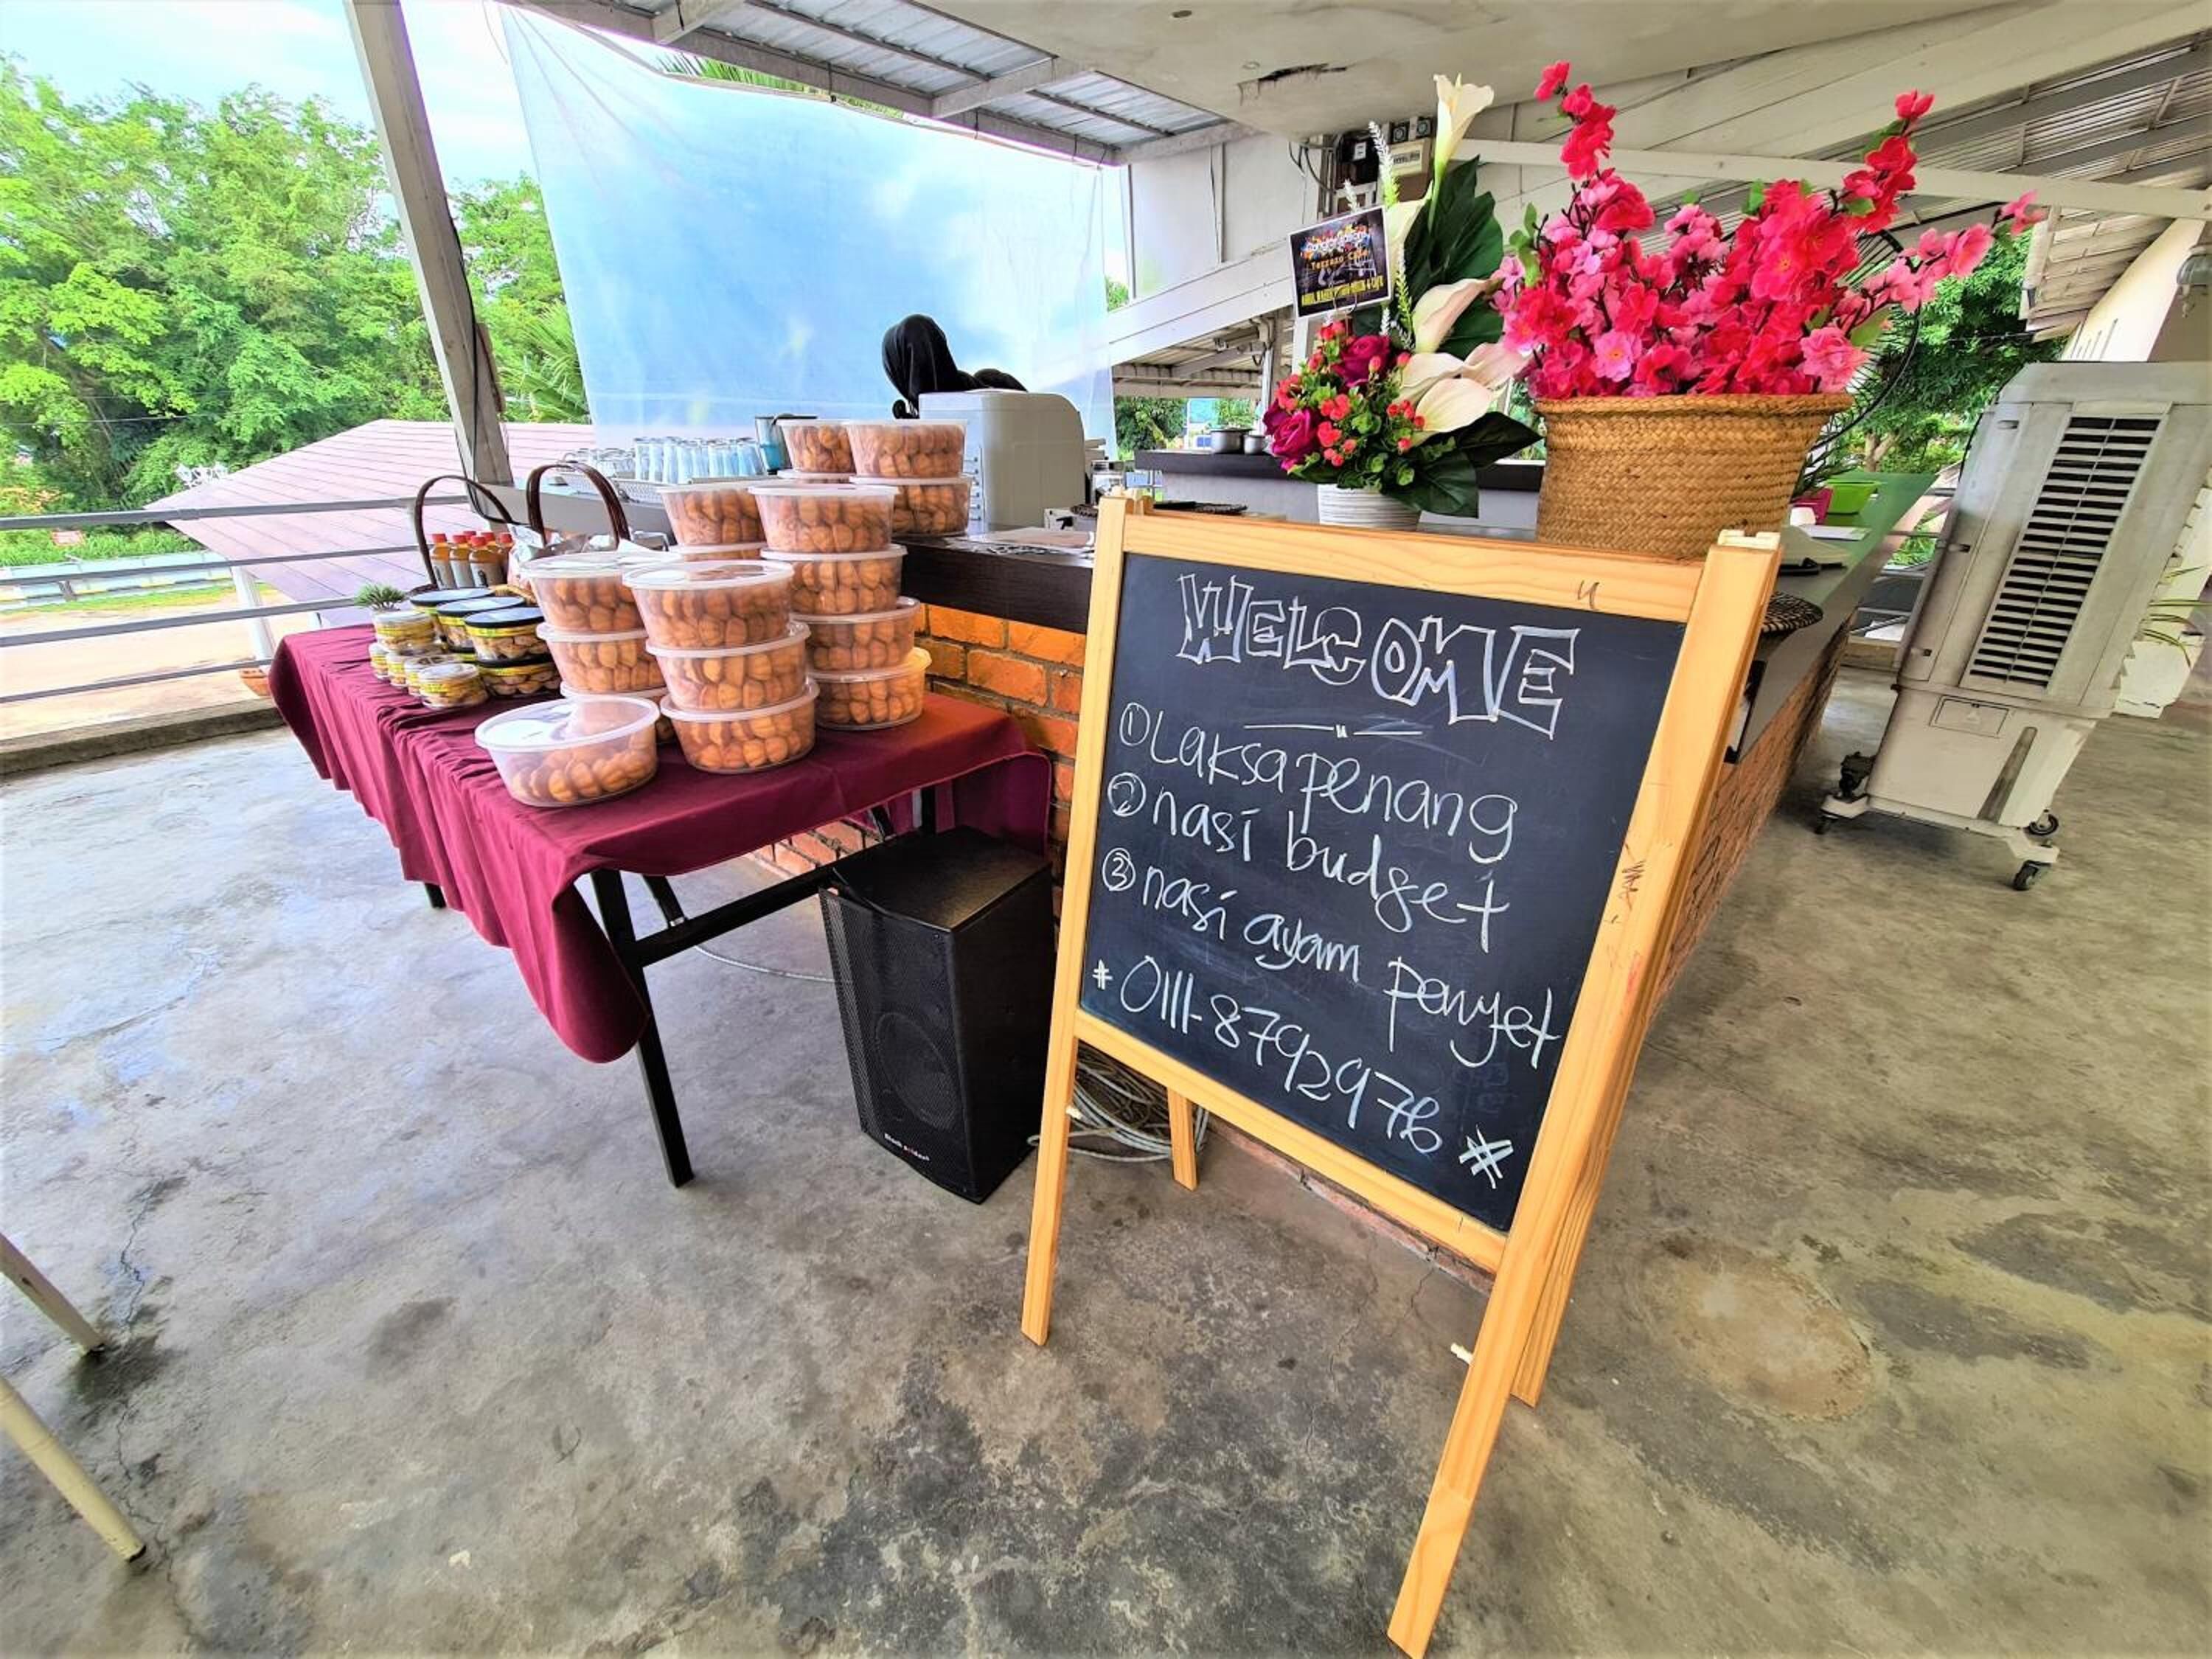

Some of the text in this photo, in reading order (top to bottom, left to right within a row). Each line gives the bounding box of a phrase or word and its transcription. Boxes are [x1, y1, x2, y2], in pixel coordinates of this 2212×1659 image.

[1176, 574, 1581, 740] WELCOME
[1142, 864, 1239, 940] nasi
[1243, 913, 1360, 984] ayam
[1152, 785, 1261, 862] nasi
[1286, 810, 1510, 953] budget
